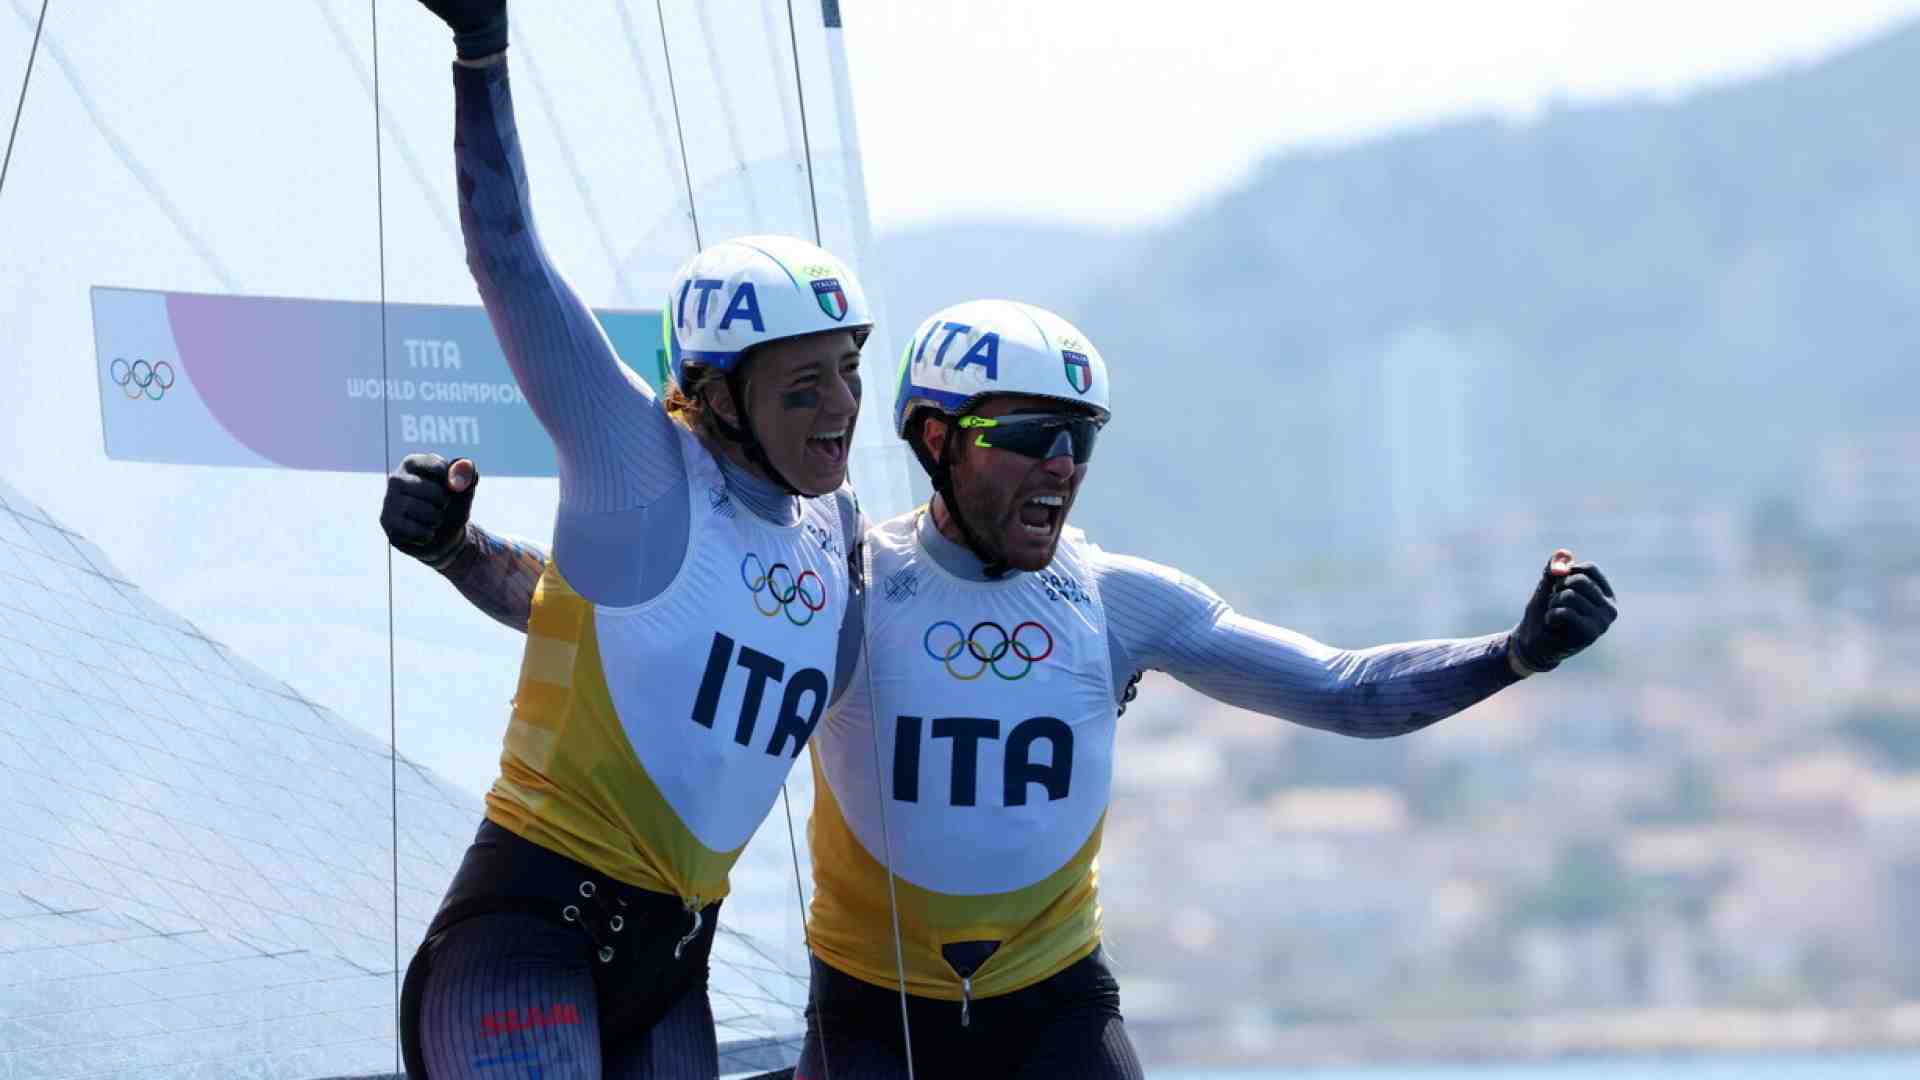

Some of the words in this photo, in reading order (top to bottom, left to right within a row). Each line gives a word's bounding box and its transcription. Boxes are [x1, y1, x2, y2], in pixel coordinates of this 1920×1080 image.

[677, 278, 765, 333] ITA
[404, 339, 462, 369] TITA
[914, 319, 1000, 381] ITA
[346, 377, 416, 400] WORLD
[401, 413, 480, 445] BANTI
[691, 631, 828, 759] ITA
[893, 716, 1074, 807] ITA
